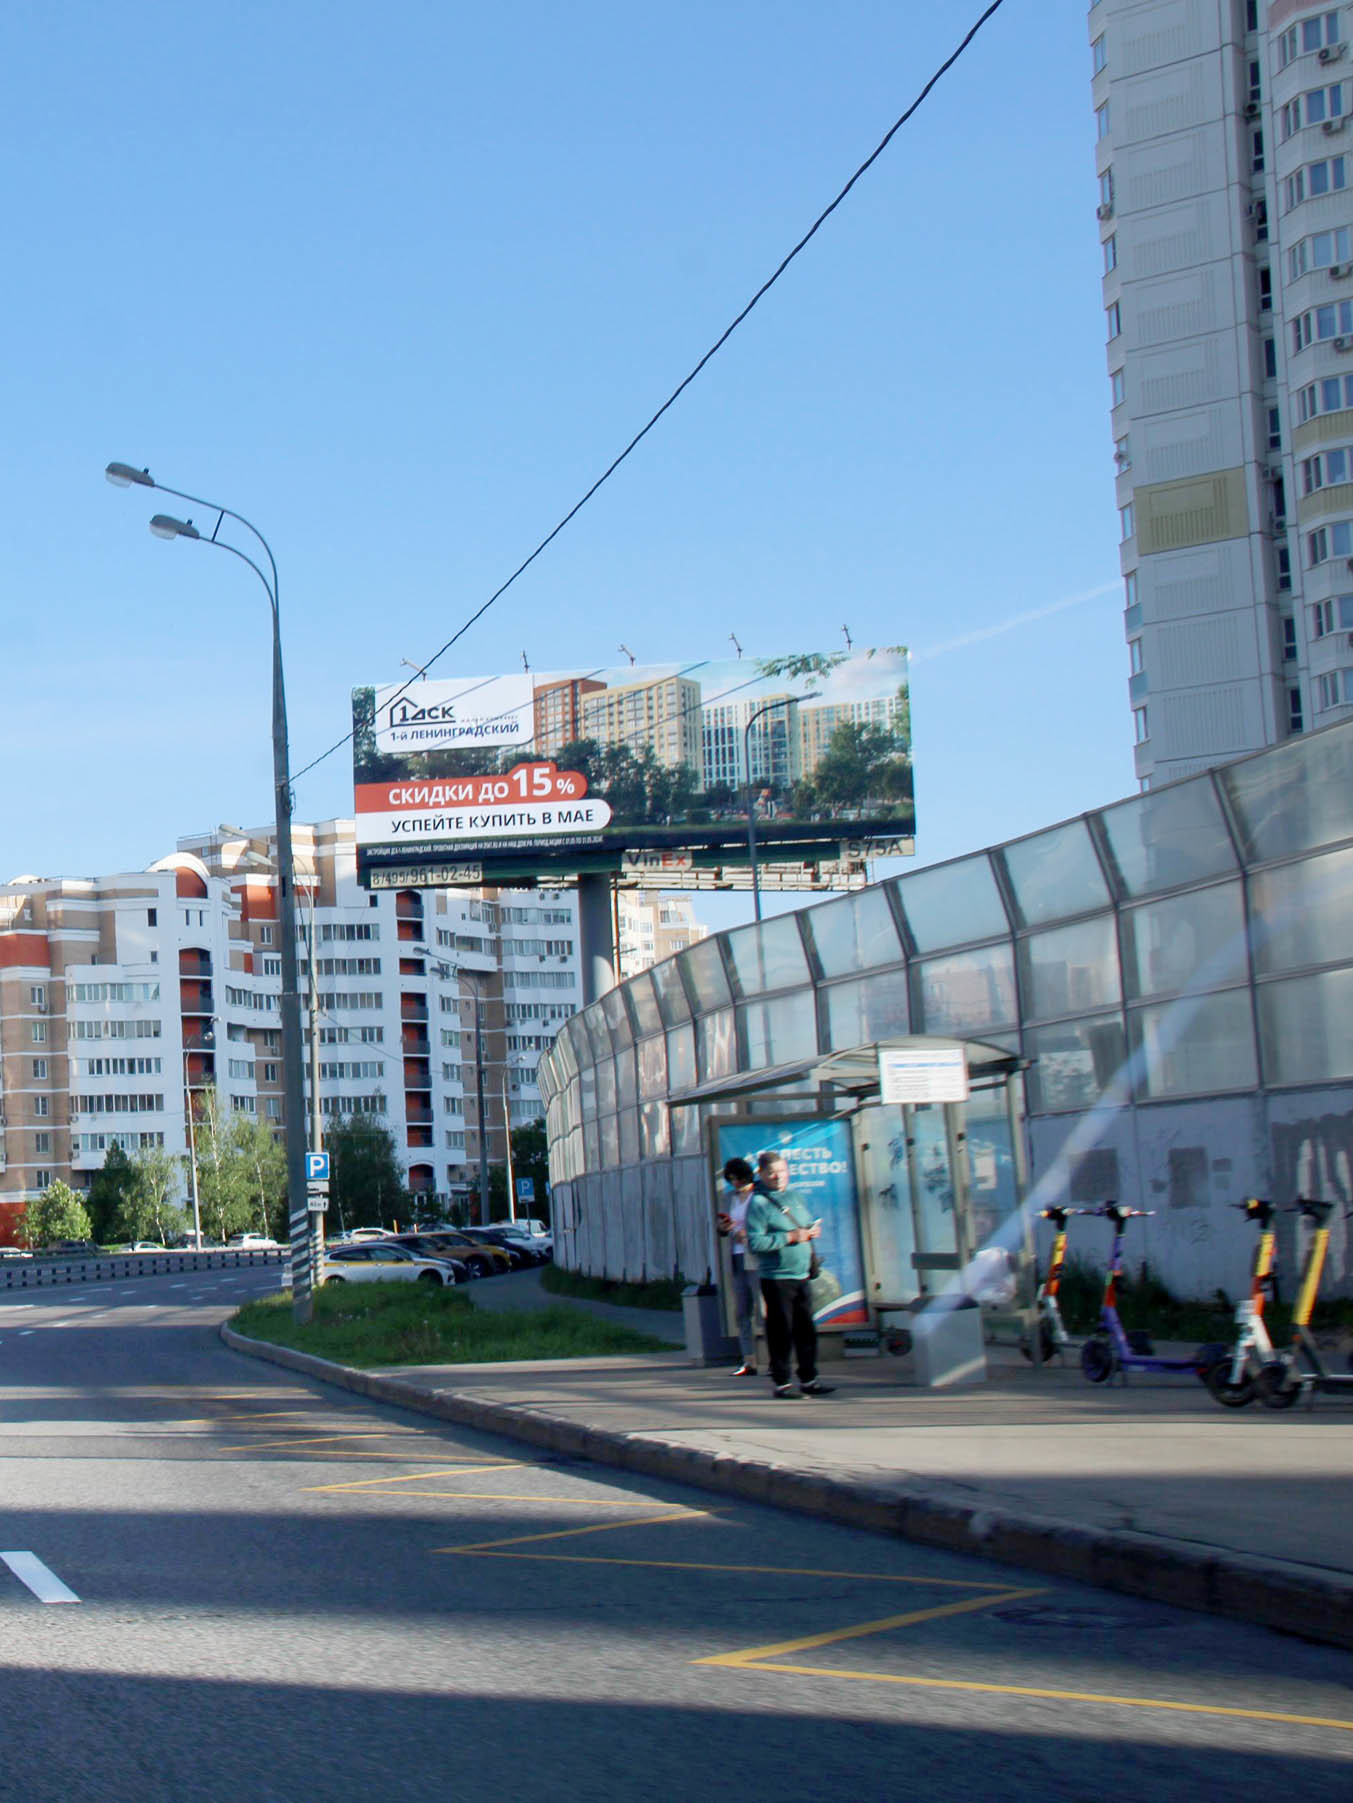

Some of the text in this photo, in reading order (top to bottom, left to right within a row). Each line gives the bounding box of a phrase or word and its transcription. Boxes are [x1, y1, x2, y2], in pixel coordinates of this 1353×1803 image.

[410, 720, 520, 740] ЛЕНИНГРАДСКИЙ
[388, 784, 474, 806] СКИДКИ
[479, 782, 509, 802] ДО
[512, 767, 552, 797] 15
[391, 808, 594, 833] УСПЕЙТЕ КУПИТЬ В МАЕ
[626, 852, 689, 867] VinEx
[310, 1155, 325, 1177] P
